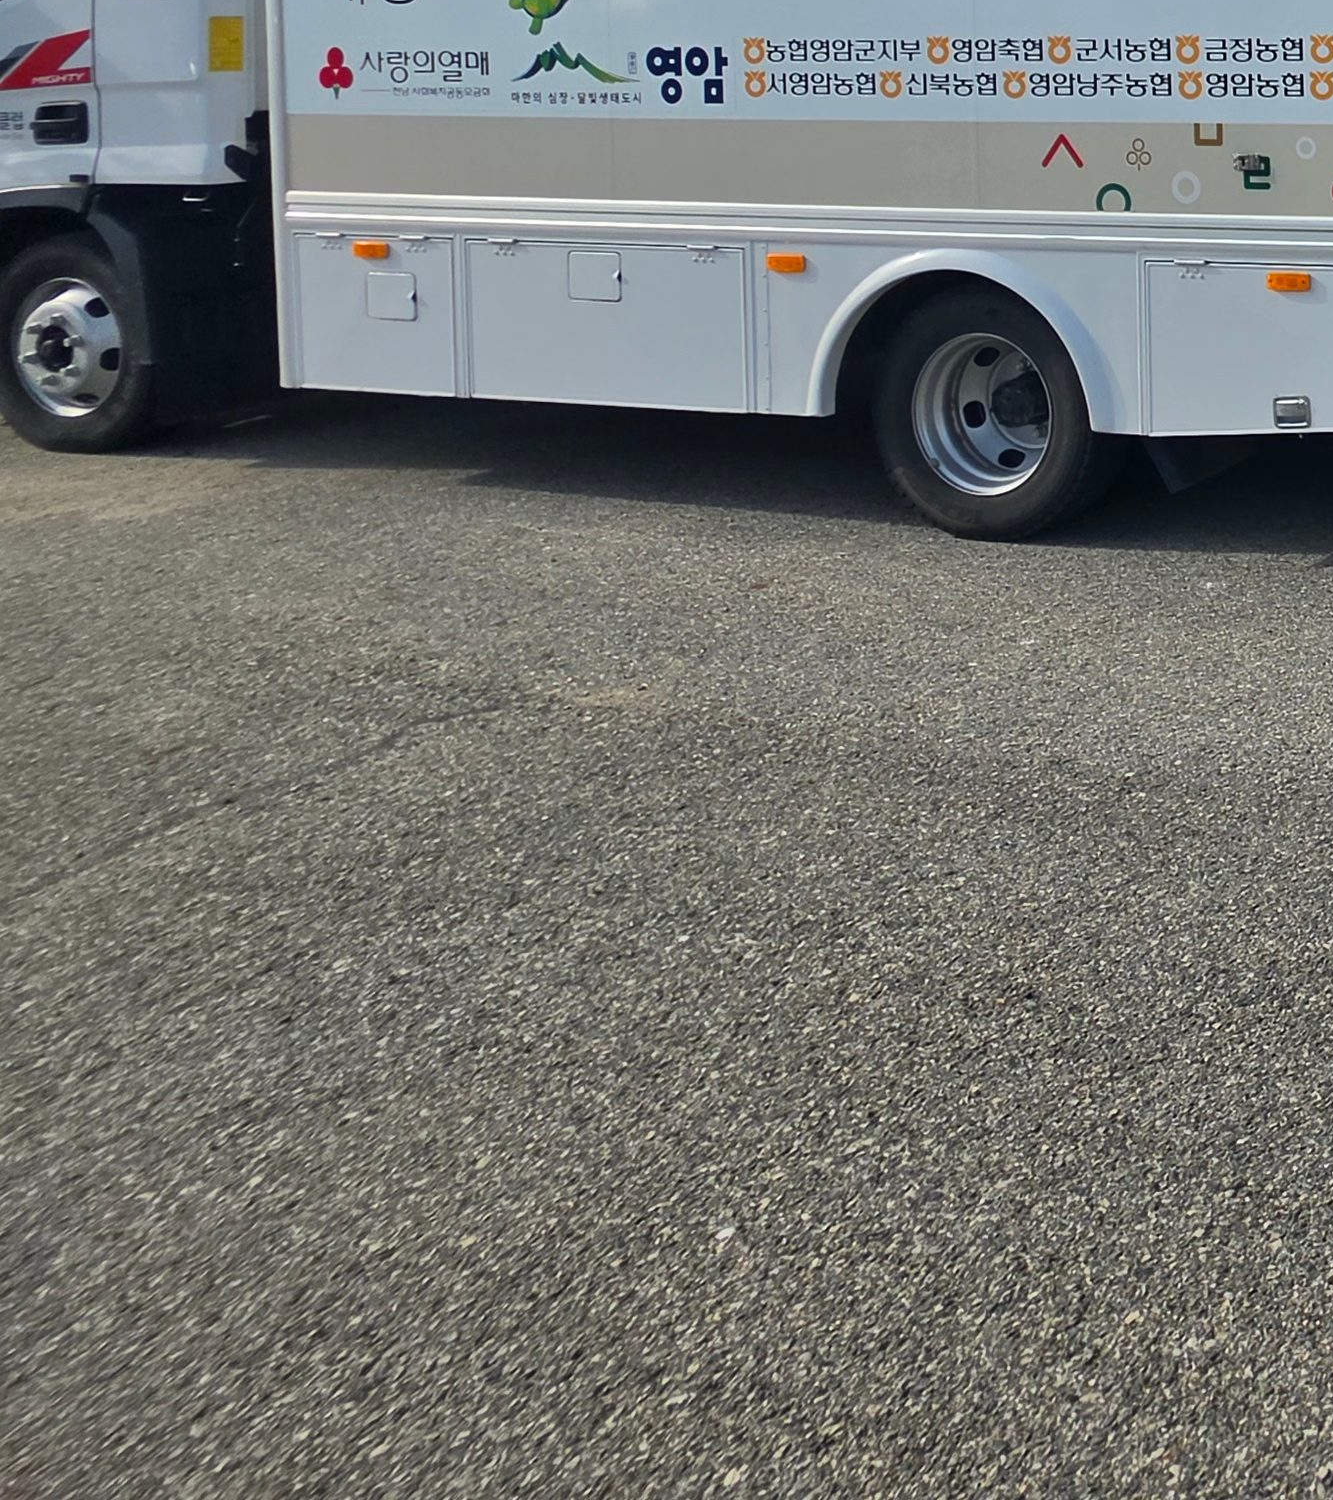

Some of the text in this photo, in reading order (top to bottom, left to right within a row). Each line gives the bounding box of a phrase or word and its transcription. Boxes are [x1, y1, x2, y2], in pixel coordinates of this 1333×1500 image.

[765, 38, 922, 62] 농협영암군지부
[951, 37, 1044, 62] 영암축협
[1075, 37, 1172, 62] 군서농협
[1204, 37, 1304, 63] 금정농협
[360, 50, 491, 83] 사랑의열매
[645, 46, 729, 105] 영암
[766, 72, 877, 97] 서영암농협
[906, 72, 998, 97] 신북농협
[1029, 73, 1172, 98] 영암낭주농협
[1205, 73, 1305, 98] 영암농협
